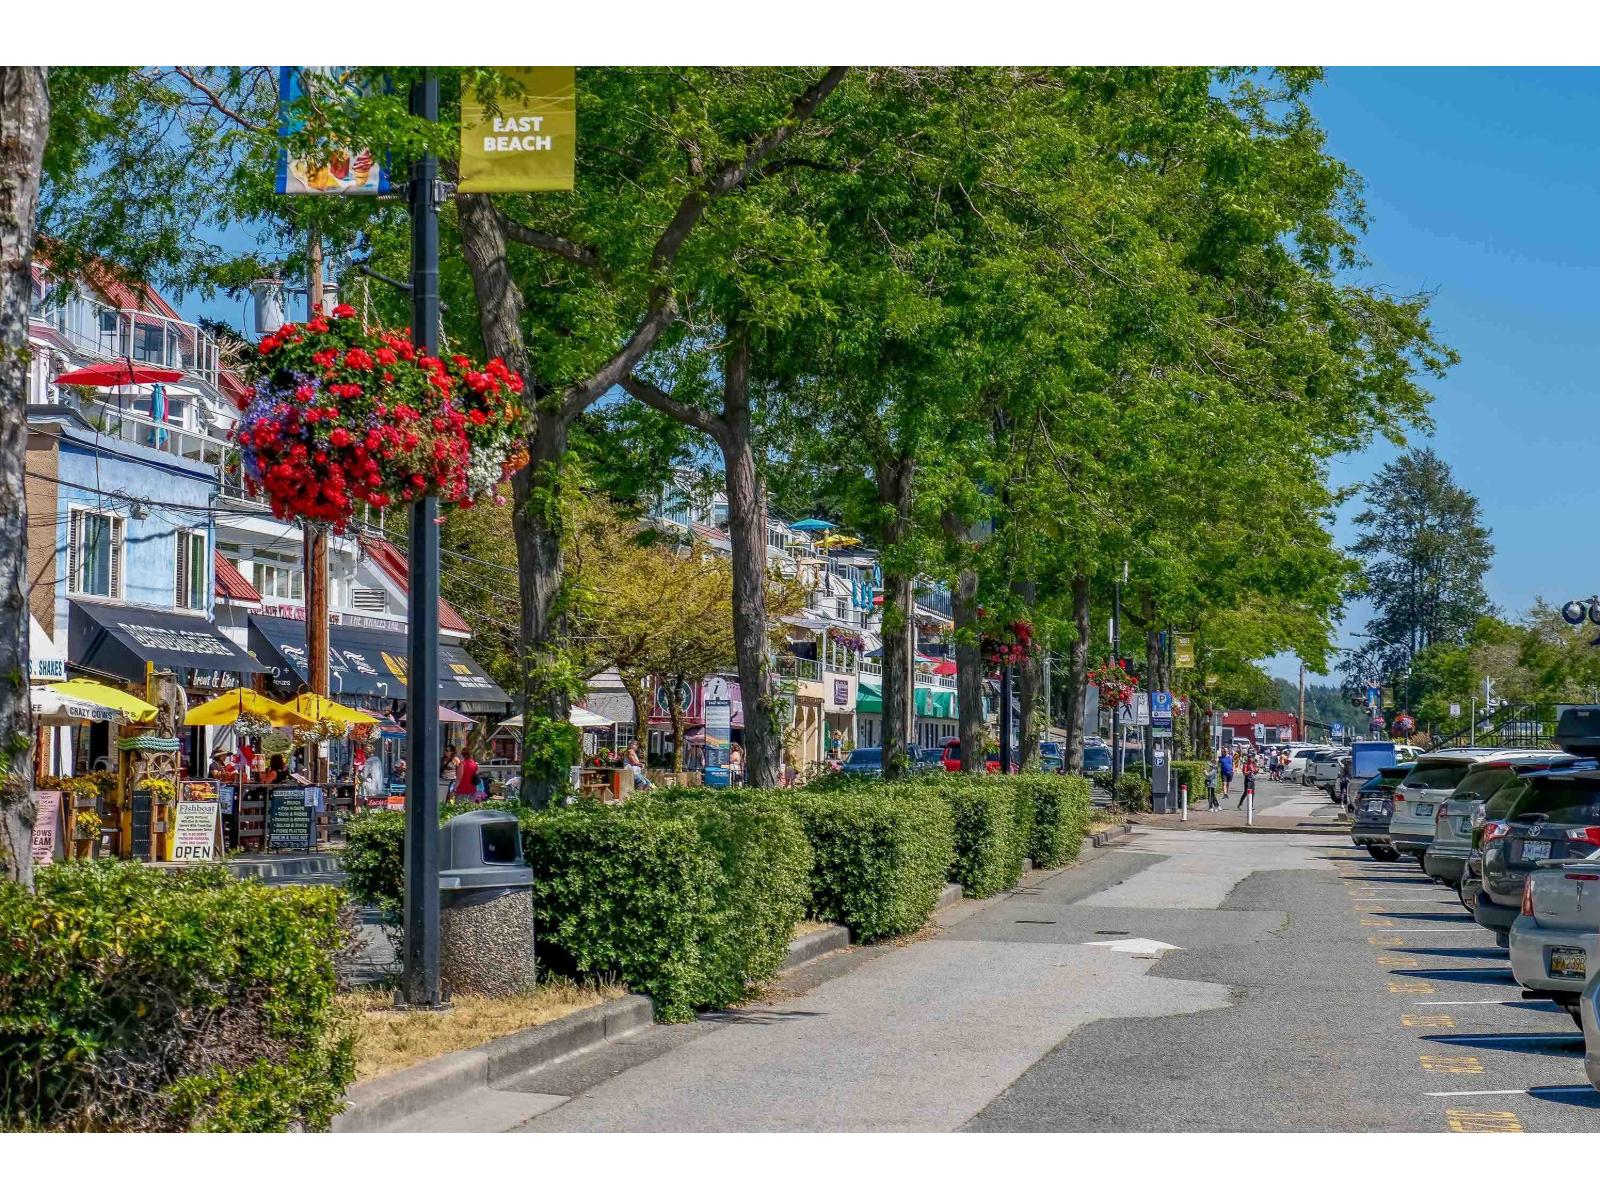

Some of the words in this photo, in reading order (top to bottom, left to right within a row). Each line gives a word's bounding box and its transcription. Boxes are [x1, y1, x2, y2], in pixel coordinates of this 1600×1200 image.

[493, 116, 544, 132] EAST
[483, 135, 551, 152] BEACH
[38, 660, 63, 676] SHAKES
[69, 706, 90, 717] CRAZY
[91, 709, 113, 720] COWS
[180, 804, 215, 812] Fishboat
[33, 837, 51, 845] EAM
[175, 846, 211, 858] OPEN
